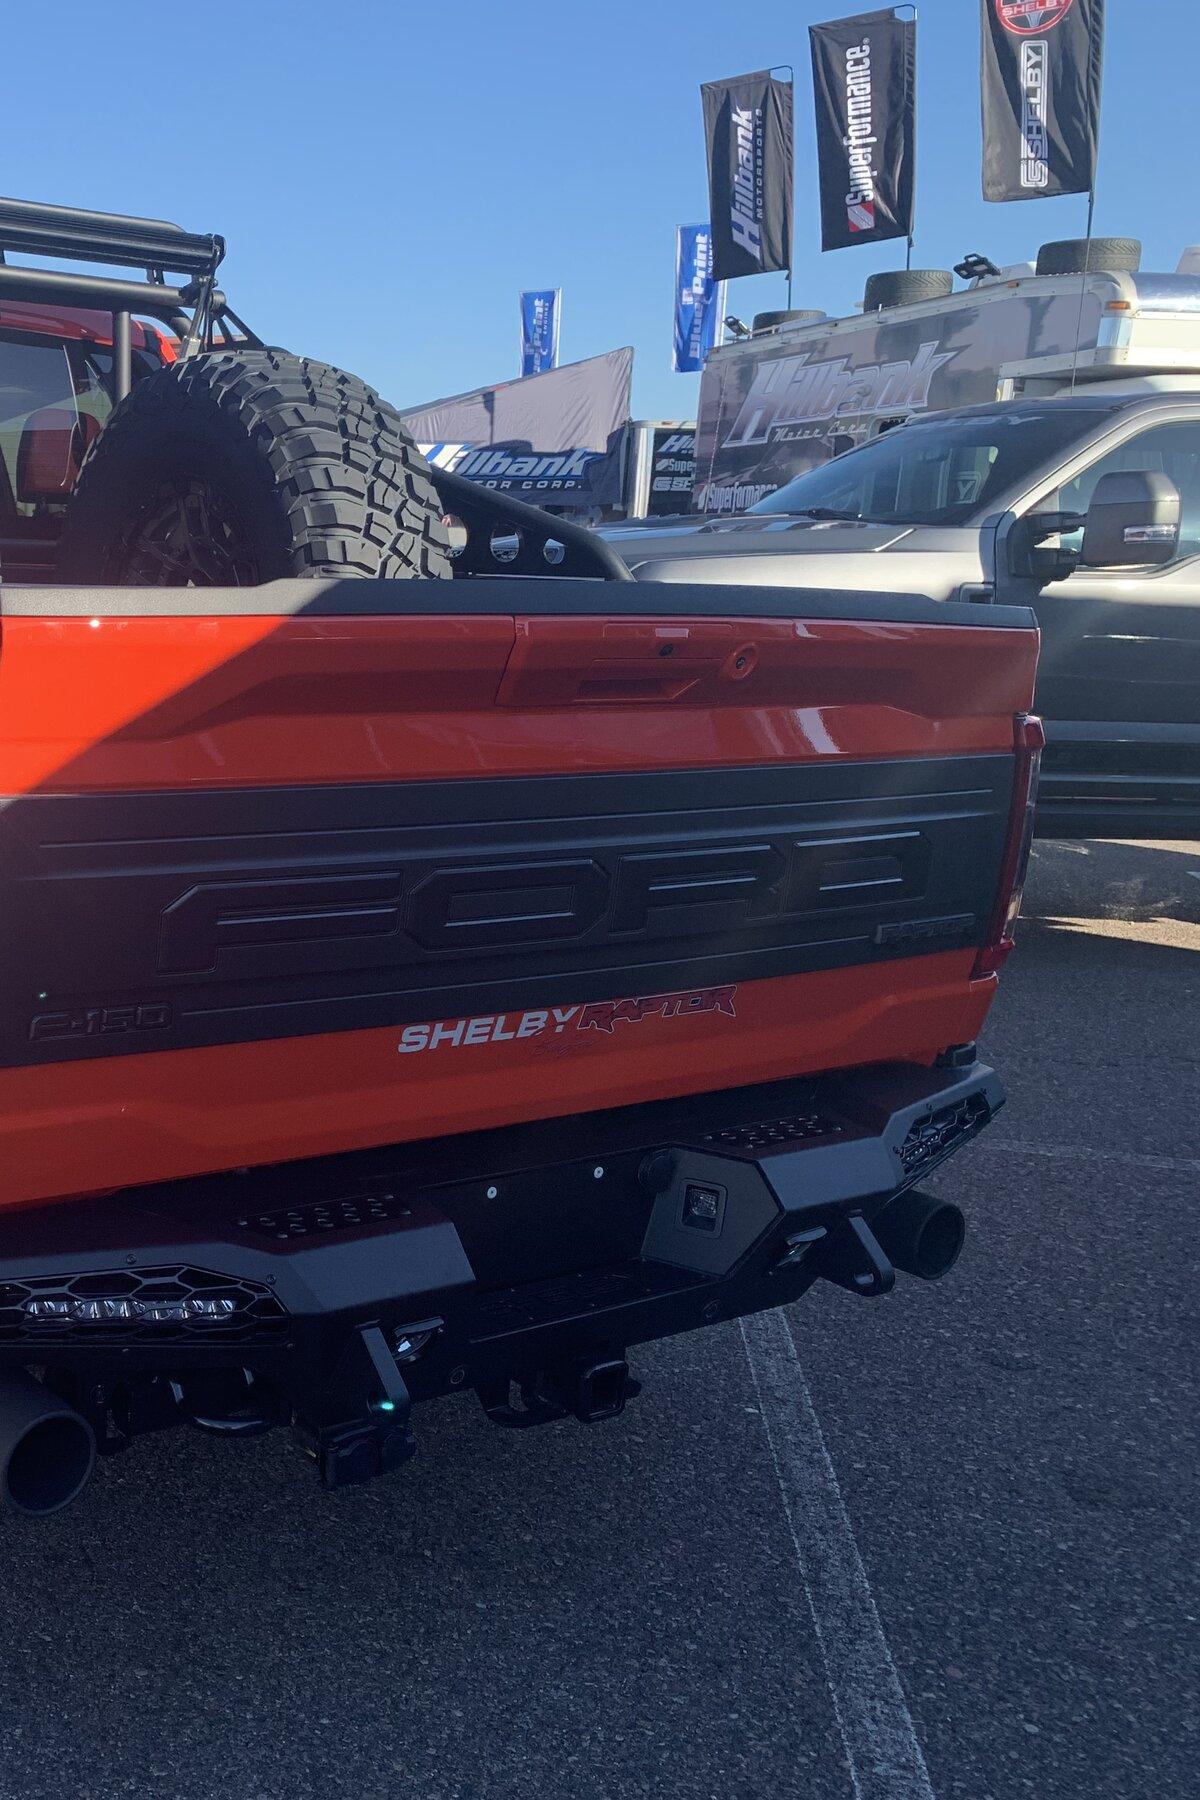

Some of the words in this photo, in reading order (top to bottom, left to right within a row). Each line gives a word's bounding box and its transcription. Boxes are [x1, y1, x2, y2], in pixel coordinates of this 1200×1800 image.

[843, 45, 877, 206] Superformance
[1026, 48, 1042, 158] SHELBY
[731, 105, 761, 260] Hillbank
[692, 233, 708, 294] Print
[721, 340, 960, 448] Hillbank
[521, 480, 582, 489] CORP.
[154, 829, 933, 976] FORD
[28, 1003, 174, 1043] F-150
[397, 1006, 580, 1053] SHELBY
[577, 984, 738, 1034] RAPTOR
